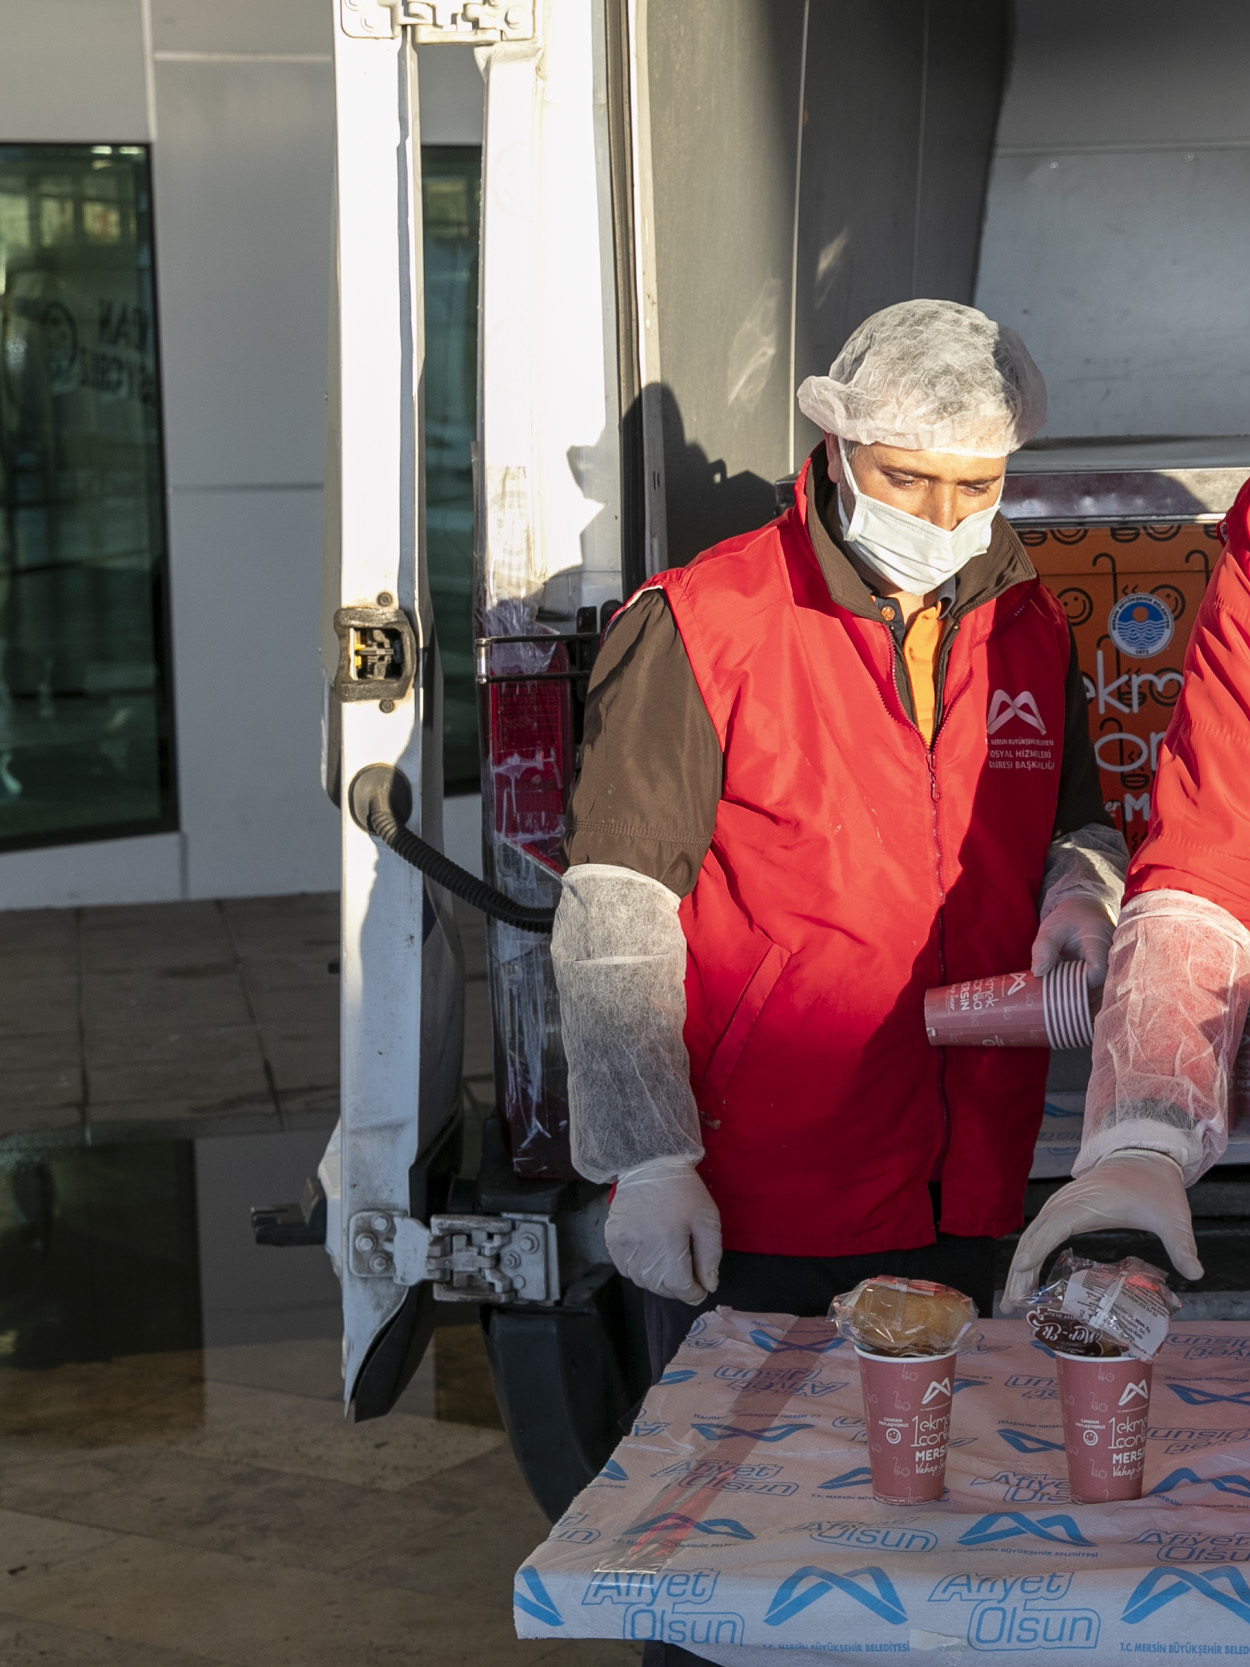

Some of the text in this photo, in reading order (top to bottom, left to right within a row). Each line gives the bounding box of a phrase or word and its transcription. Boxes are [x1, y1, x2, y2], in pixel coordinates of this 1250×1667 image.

[915, 1444, 947, 1462] MERS
[1112, 1449, 1144, 1465] MERS
[631, 1608, 739, 1644] Olsun
[975, 1606, 1093, 1643] Olsun
[1120, 1642, 1132, 1652] T.C.
[1134, 1641, 1166, 1653] MERSİN
[1169, 1642, 1222, 1656] BÜYÜKŞEHİR
